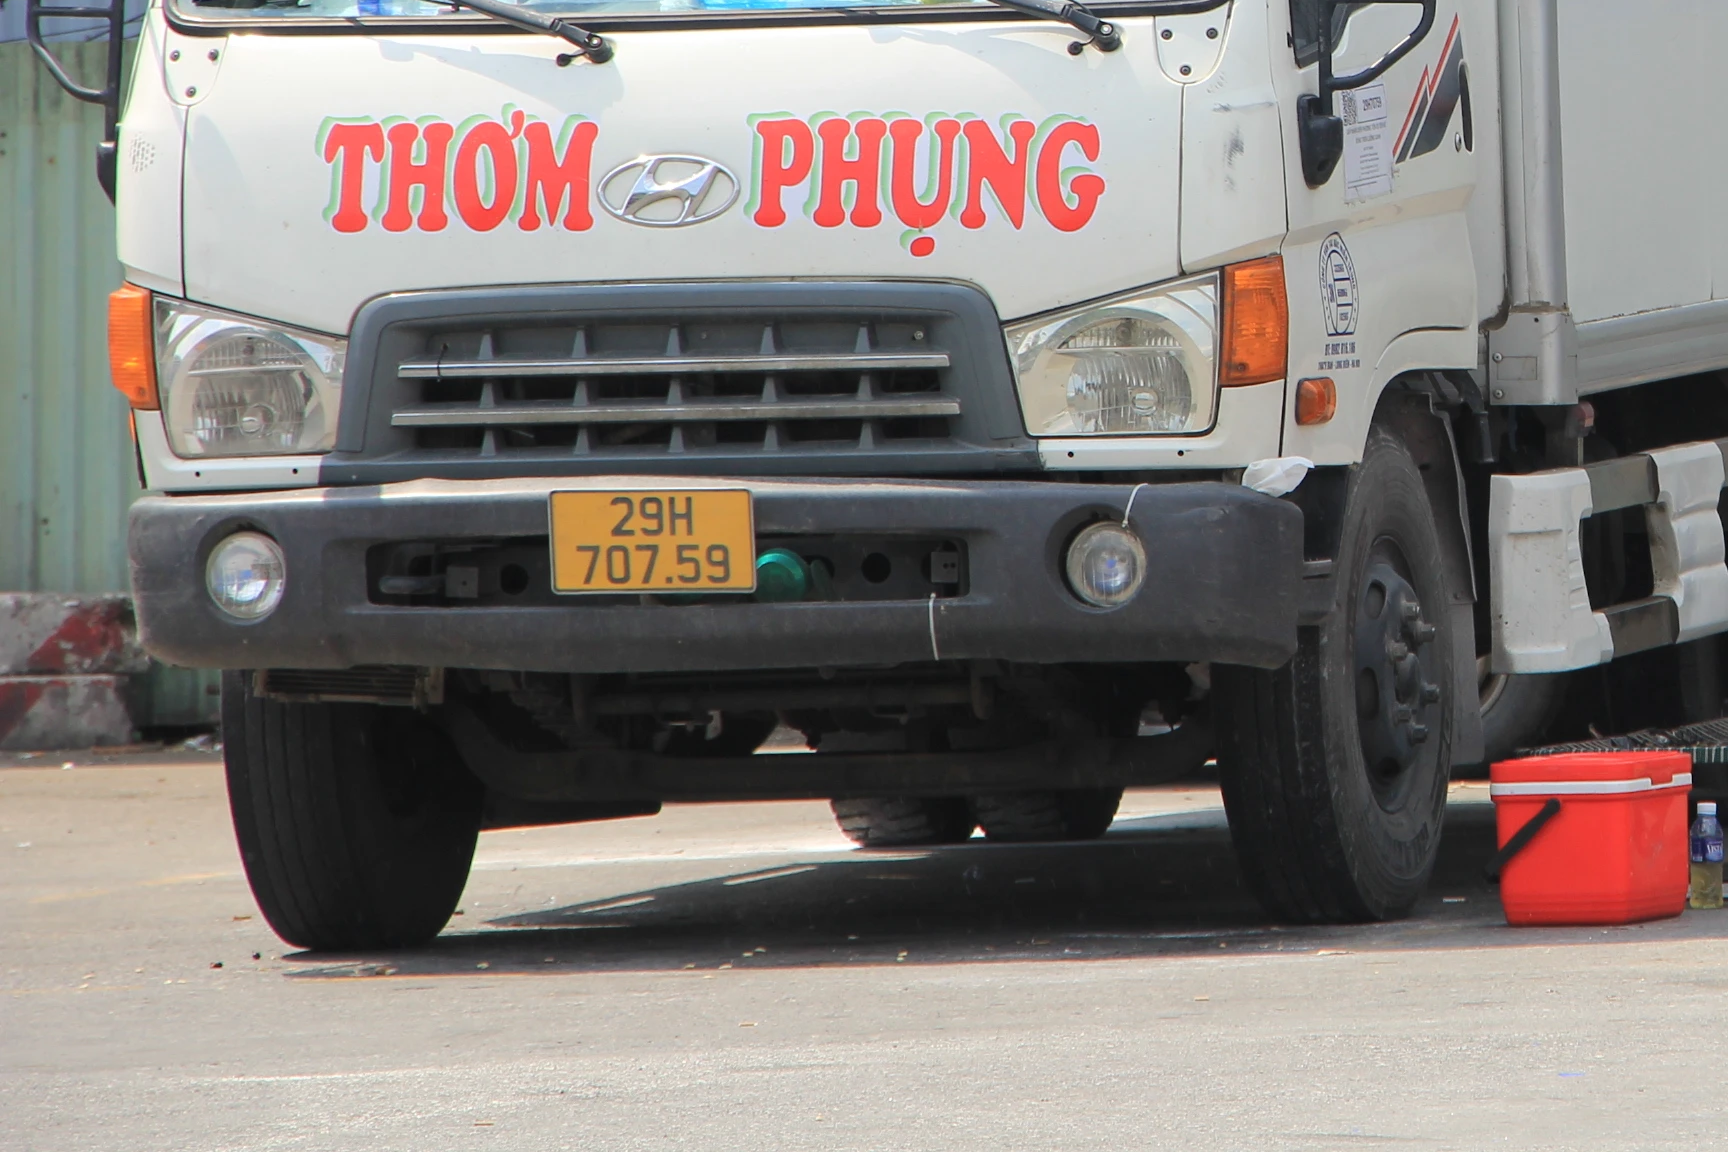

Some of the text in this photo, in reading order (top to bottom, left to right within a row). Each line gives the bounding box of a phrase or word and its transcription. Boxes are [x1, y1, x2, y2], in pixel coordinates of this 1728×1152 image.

[320, 105, 1106, 257] THƠM PHỤNG
[610, 496, 693, 537] 29H
[576, 544, 731, 585] 707.59
